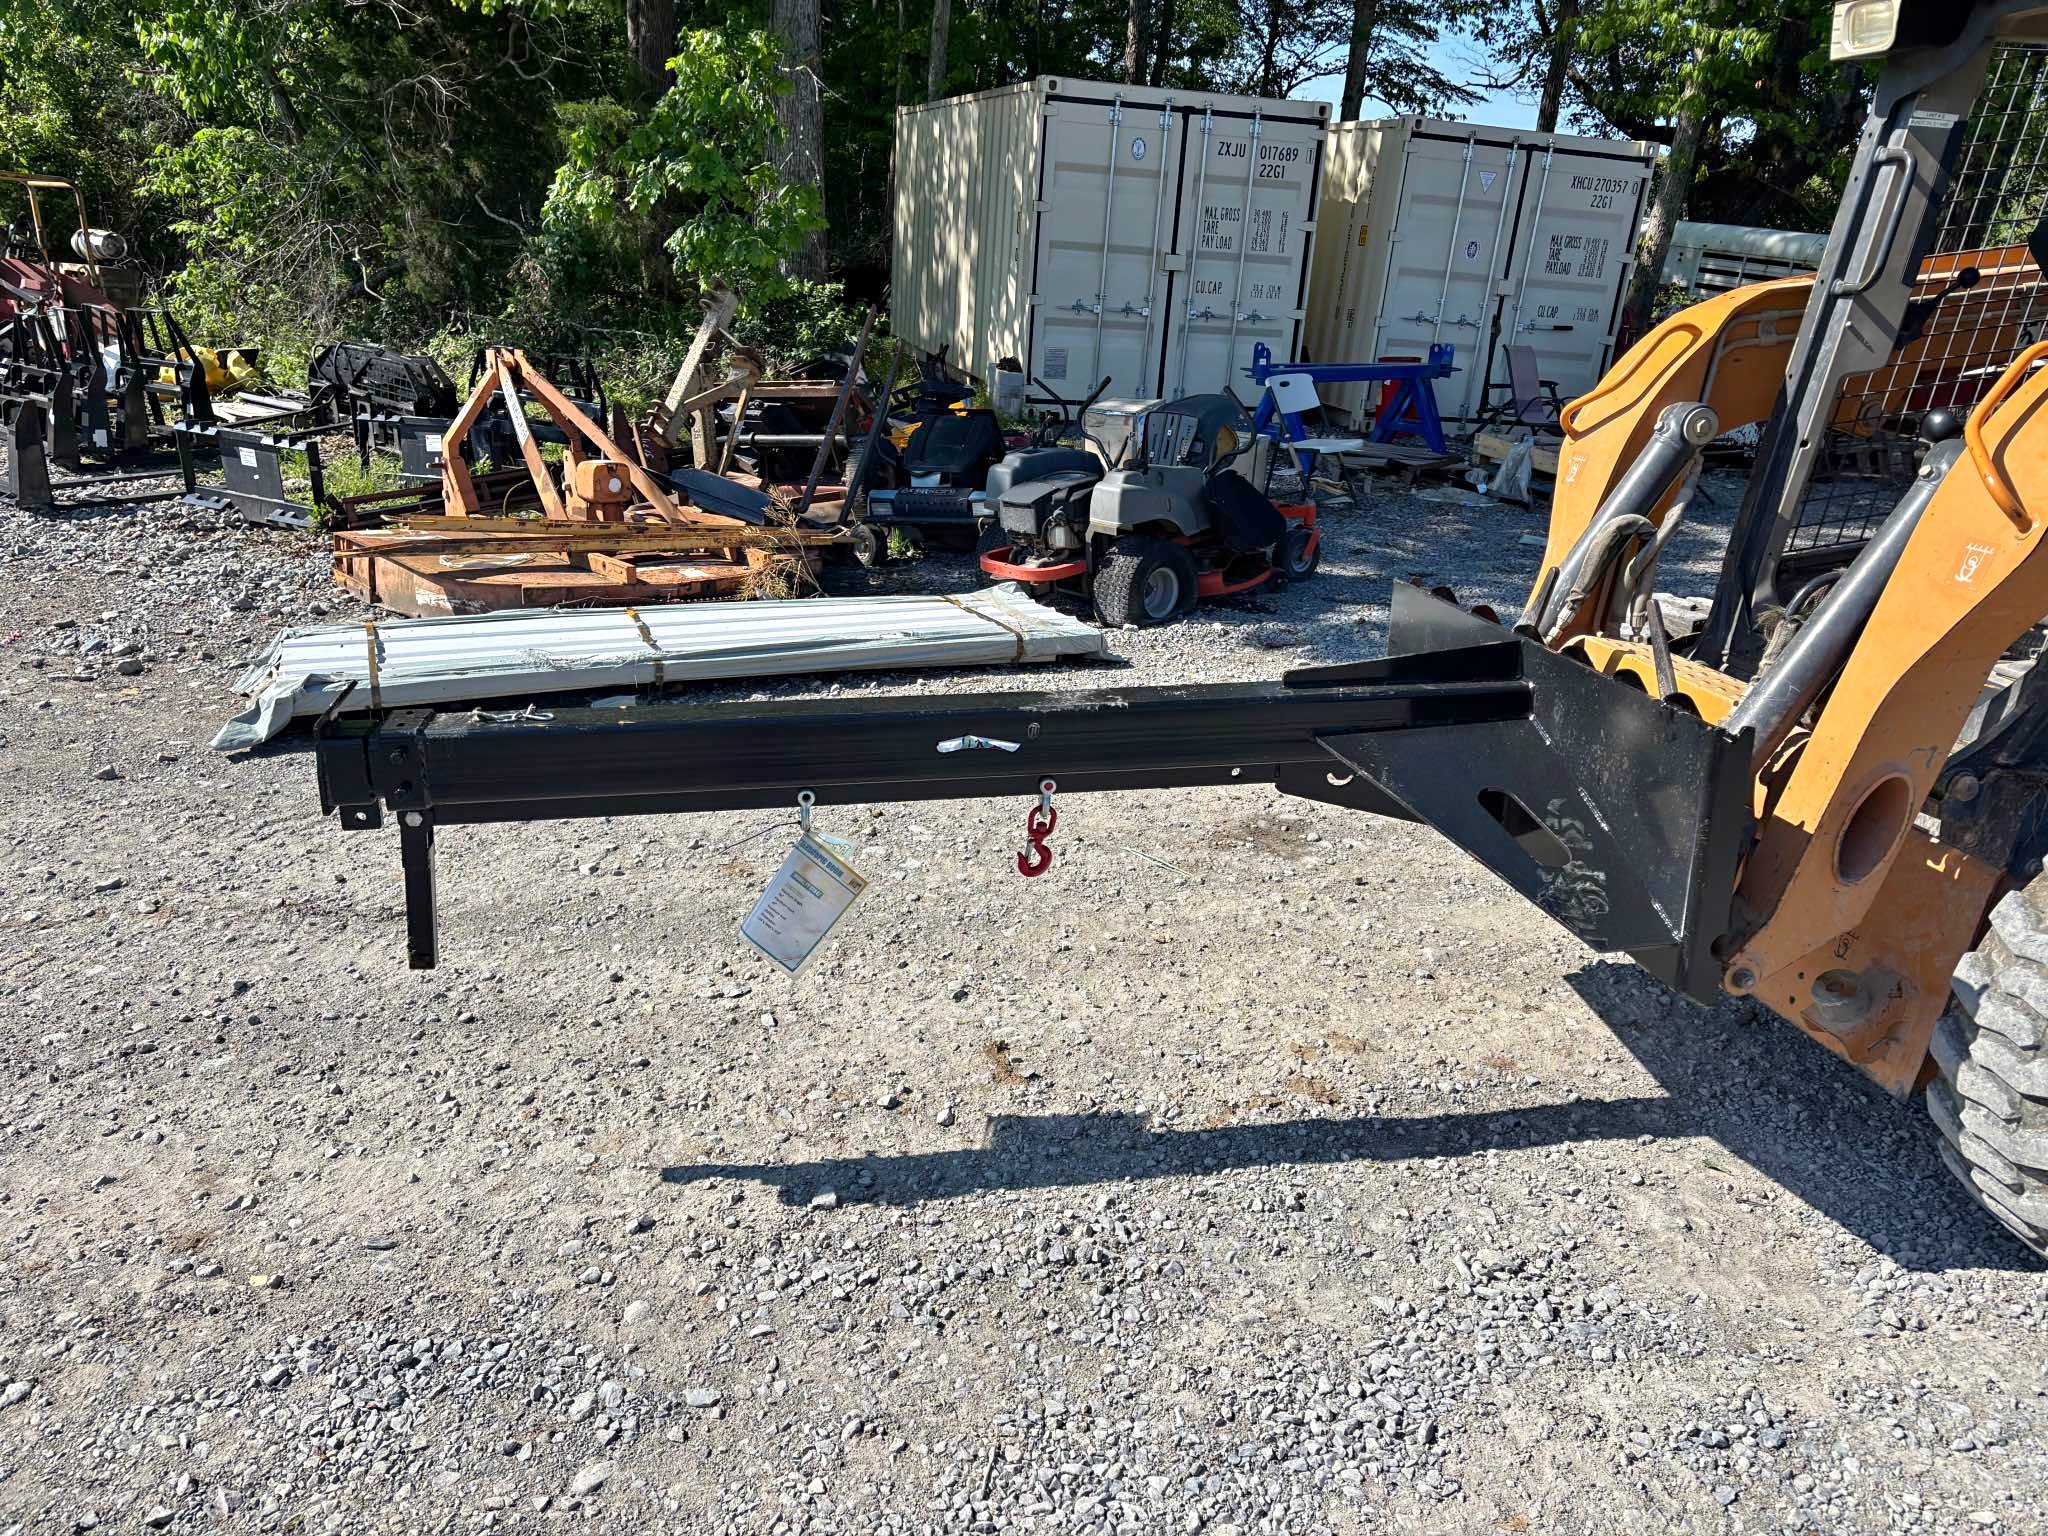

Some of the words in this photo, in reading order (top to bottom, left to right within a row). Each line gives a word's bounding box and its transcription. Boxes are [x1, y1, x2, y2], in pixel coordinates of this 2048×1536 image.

[1217, 141, 1247, 158] ZXJU
[1260, 145, 1299, 162] 017689
[1259, 163, 1286, 179] 22G1
[1570, 175, 1594, 191] XHCU
[1594, 178, 1629, 195] 270357
[1590, 194, 1613, 209] 22G1
[1220, 207, 1241, 222] GROSS
[1202, 219, 1219, 235] TARE
[1563, 235, 1583, 250] GROSS
[1548, 248, 1563, 262] TARE
[1544, 261, 1572, 275] PAYLOAD
